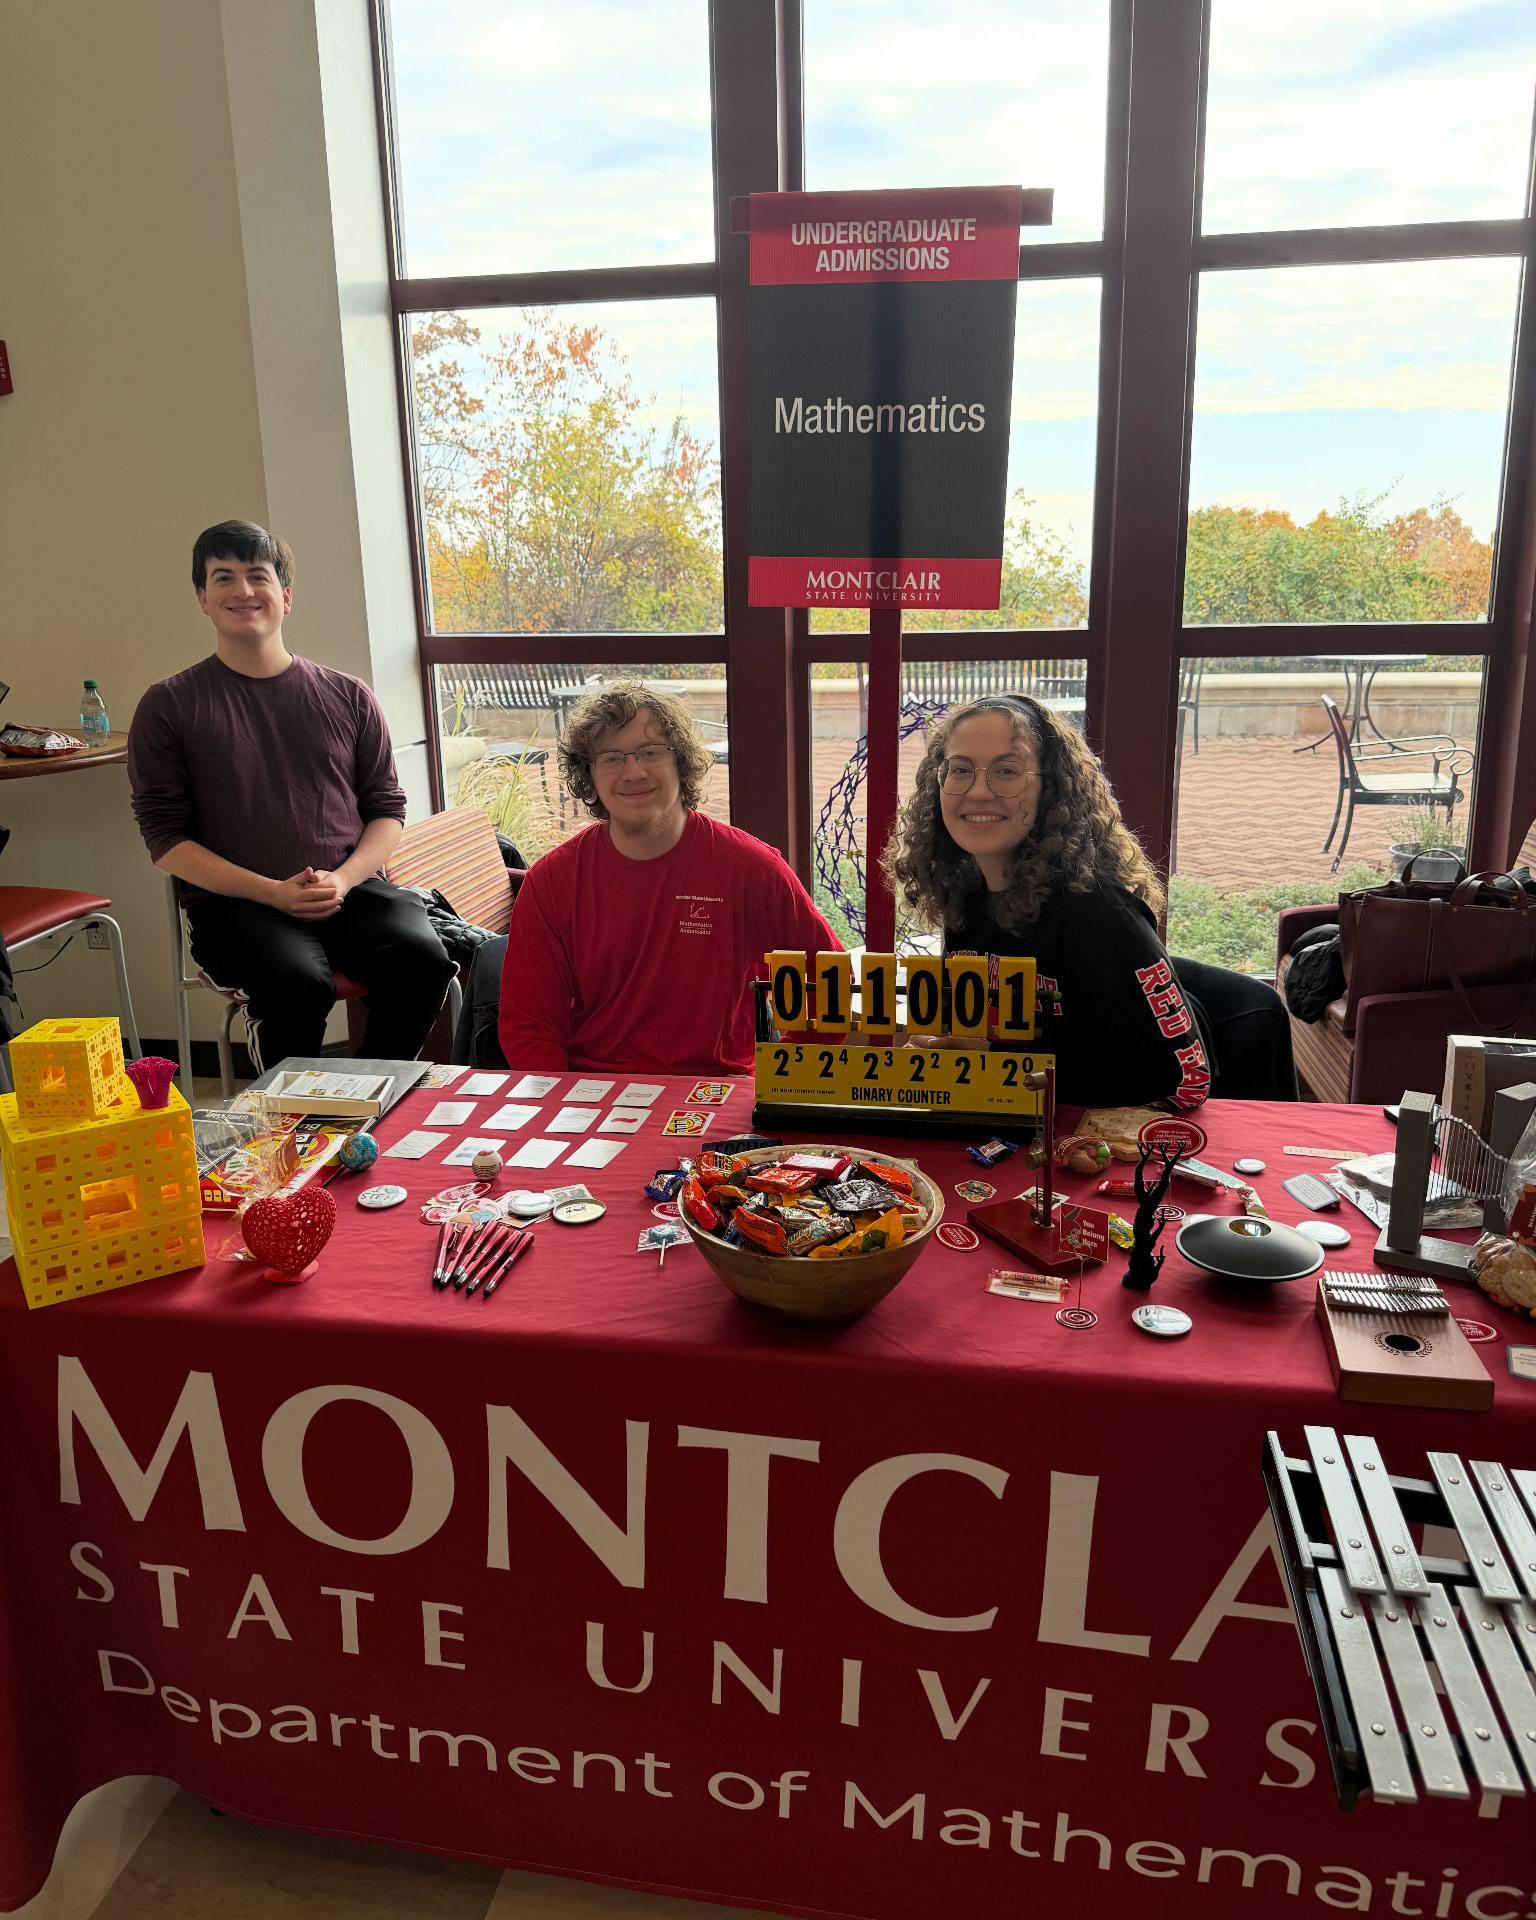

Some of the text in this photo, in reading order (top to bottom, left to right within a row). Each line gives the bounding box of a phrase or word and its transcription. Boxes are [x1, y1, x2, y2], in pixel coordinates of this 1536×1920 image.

[790, 217, 977, 246] UNDERGRADUATE
[814, 246, 950, 273] ADMISSIONS
[774, 395, 985, 434] Mathematics
[805, 571, 941, 590] MONTCLAIR
[805, 590, 942, 602] STATE UNIVERSITY
[679, 920, 713, 928] Mathematics
[679, 927, 712, 935] Ambassador
[1135, 957, 1192, 1039] RED
[1150, 1038, 1211, 1110] HAW
[851, 1086, 951, 1105] BINARY COUNTER
[360, 1192, 399, 1202] STEM
[1082, 1219, 1095, 1229] You
[1082, 1228, 1105, 1242] Belong
[1082, 1238, 1098, 1248] Here
[57, 1354, 1448, 1694] MONTCLA
[69, 1541, 467, 1671] STATE
[585, 1620, 1500, 1818] UNIVERS
[97, 1648, 1536, 1920] Department of Mathematic
